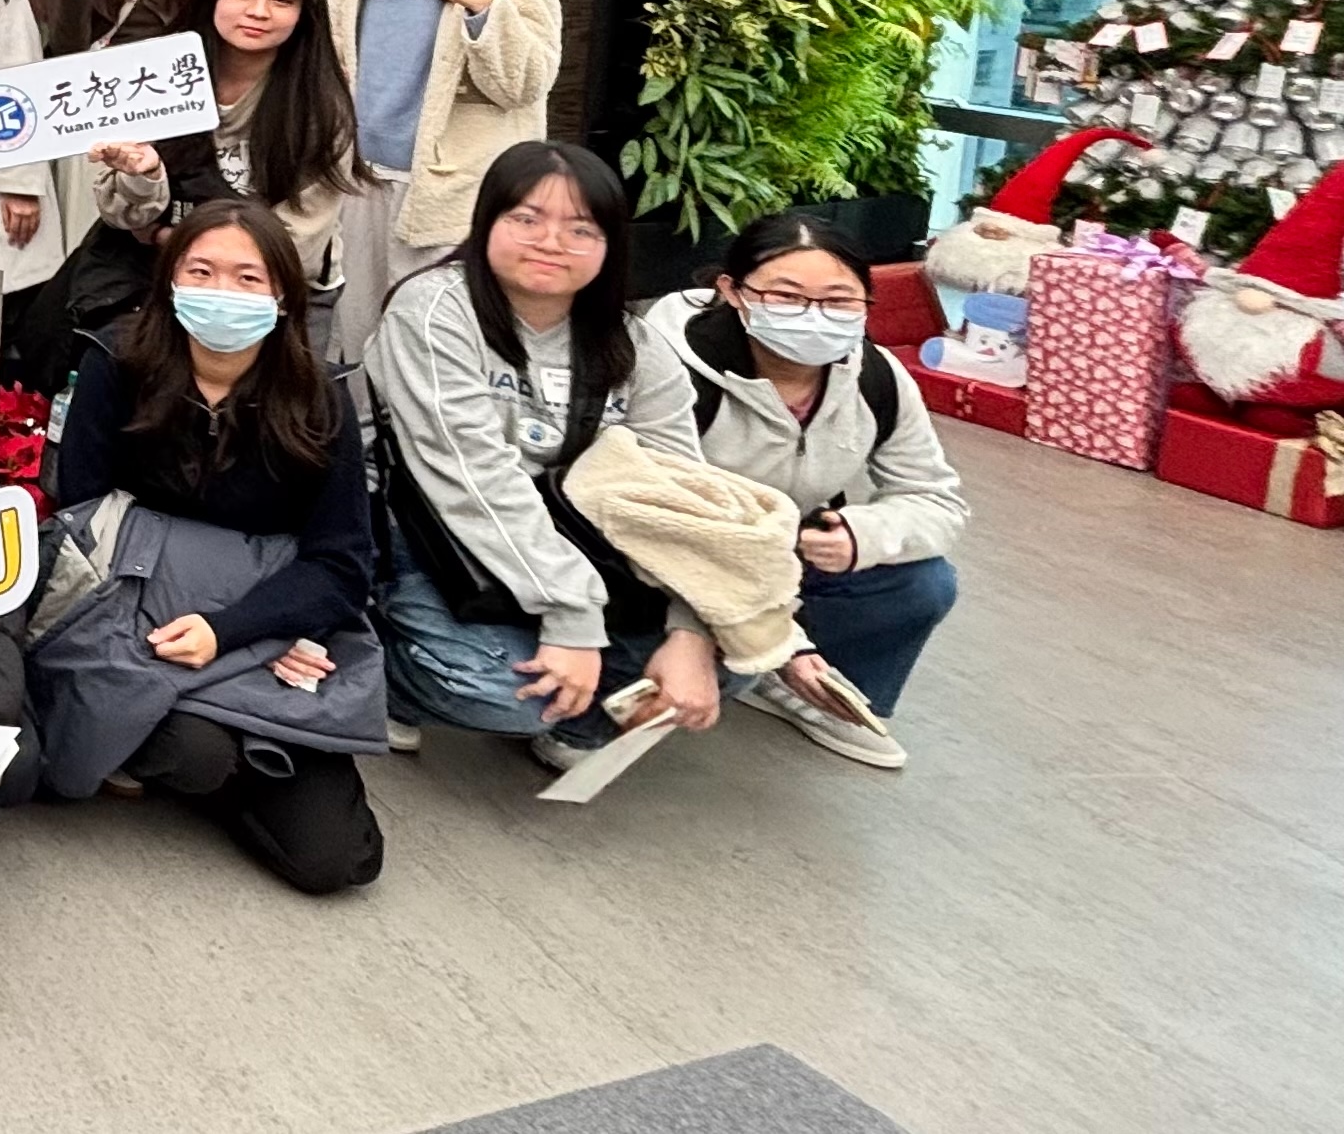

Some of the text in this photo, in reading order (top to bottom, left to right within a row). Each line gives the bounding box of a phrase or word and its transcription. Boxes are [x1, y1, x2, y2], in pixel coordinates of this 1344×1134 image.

[43, 53, 205, 121] 元智大學
[52, 99, 206, 136] Yuan Ze University
